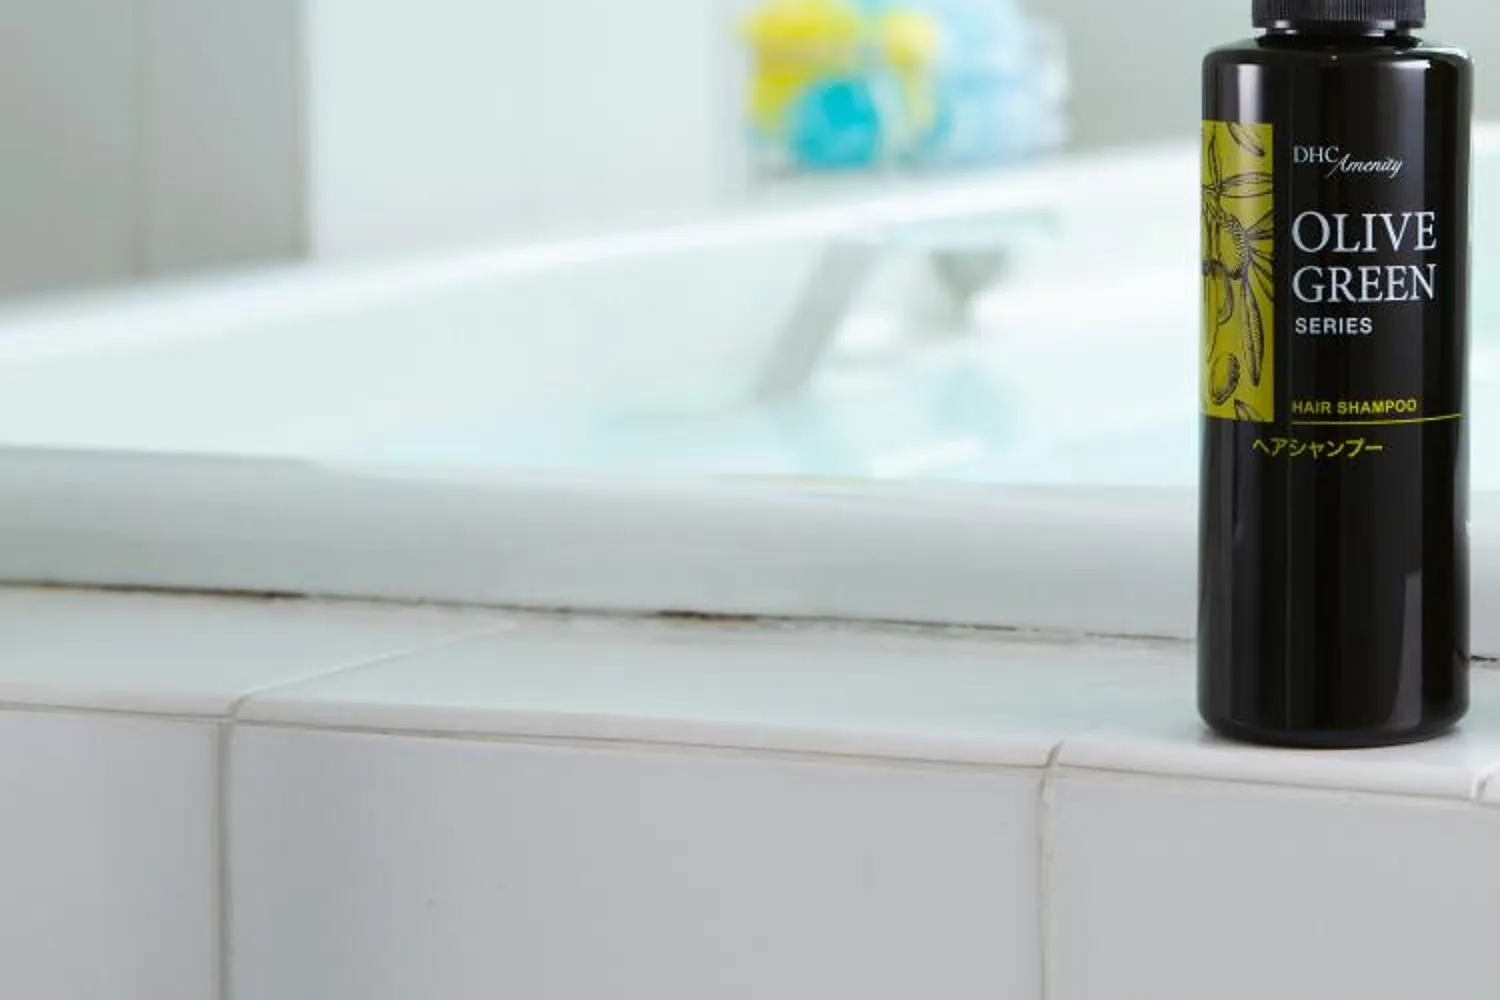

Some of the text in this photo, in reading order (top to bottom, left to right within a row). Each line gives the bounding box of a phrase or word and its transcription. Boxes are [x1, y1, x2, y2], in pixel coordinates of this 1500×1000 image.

[1293, 146, 1403, 178] DHC Amenity
[1292, 210, 1437, 253] OLIVE
[1292, 264, 1437, 303] GREEN
[1295, 317, 1373, 334] SERIES
[1292, 399, 1417, 414] HAIR SHAMPOO
[1252, 437, 1383, 459] ヘアシャンプー
